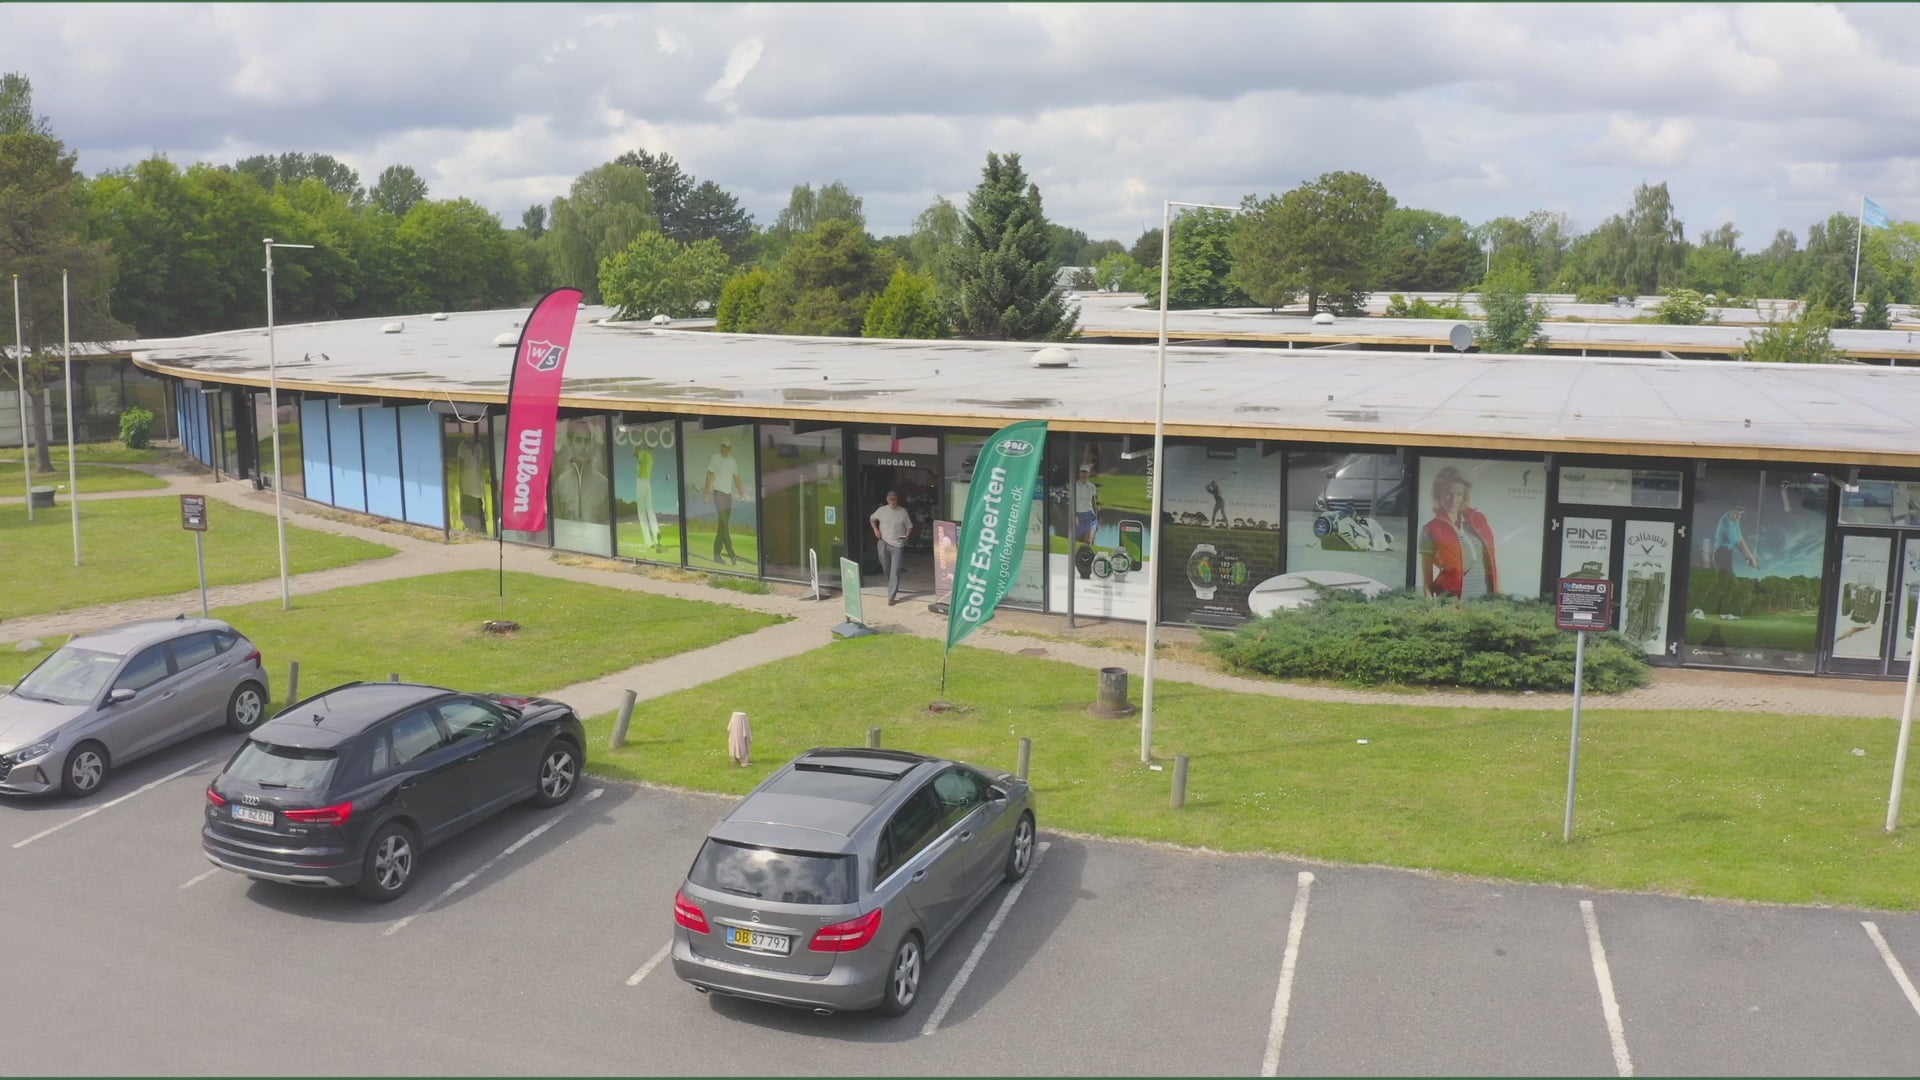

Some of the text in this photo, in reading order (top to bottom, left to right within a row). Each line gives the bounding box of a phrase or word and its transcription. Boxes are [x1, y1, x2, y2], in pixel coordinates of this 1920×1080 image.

[877, 458, 916, 467] INDGANG
[513, 429, 542, 513] Wilson
[1566, 528, 1608, 541] PING
[1627, 532, 1669, 548] Callaway
[961, 466, 1007, 622] Golf Experten
[994, 485, 1024, 602] ww.golfexperten.dk
[751, 933, 765, 946] 87
[767, 936, 787, 949] 797
